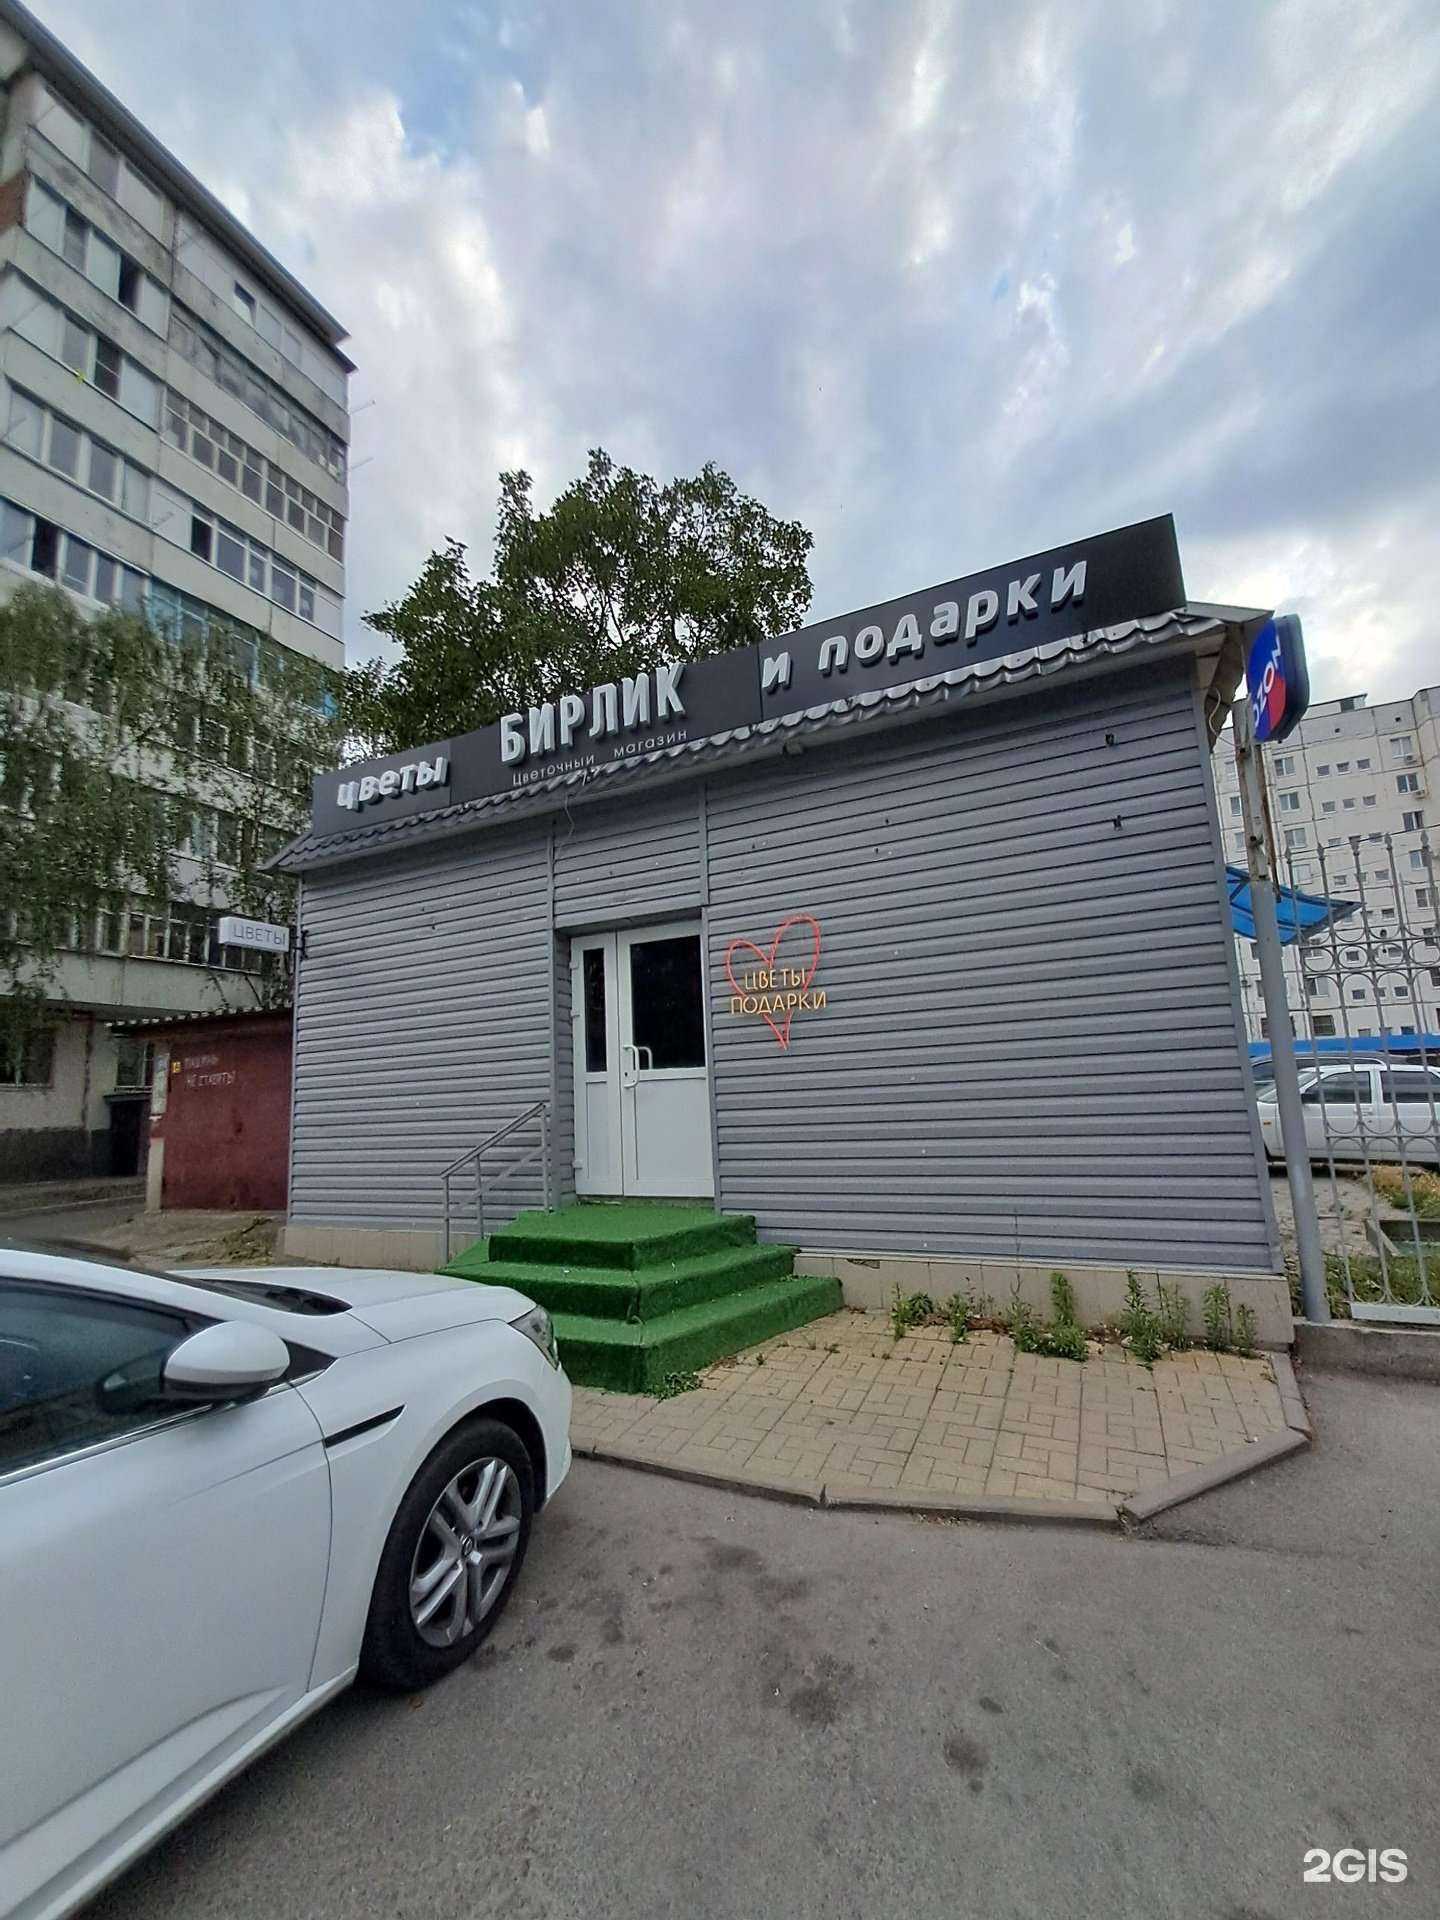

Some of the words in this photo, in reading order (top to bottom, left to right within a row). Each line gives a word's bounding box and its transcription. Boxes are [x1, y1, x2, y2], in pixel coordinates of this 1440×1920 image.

[761, 650, 793, 694] и
[818, 559, 1089, 675] подарки
[500, 664, 687, 765] БИРЛИК
[336, 757, 449, 811] цветы
[511, 753, 596, 788] Цветочный
[613, 729, 688, 759] магазин
[233, 924, 286, 947] ЦВЕТЫ
[730, 991, 827, 1015] ПОДАРКИ
[744, 967, 806, 990] ЦВЕТЫ
